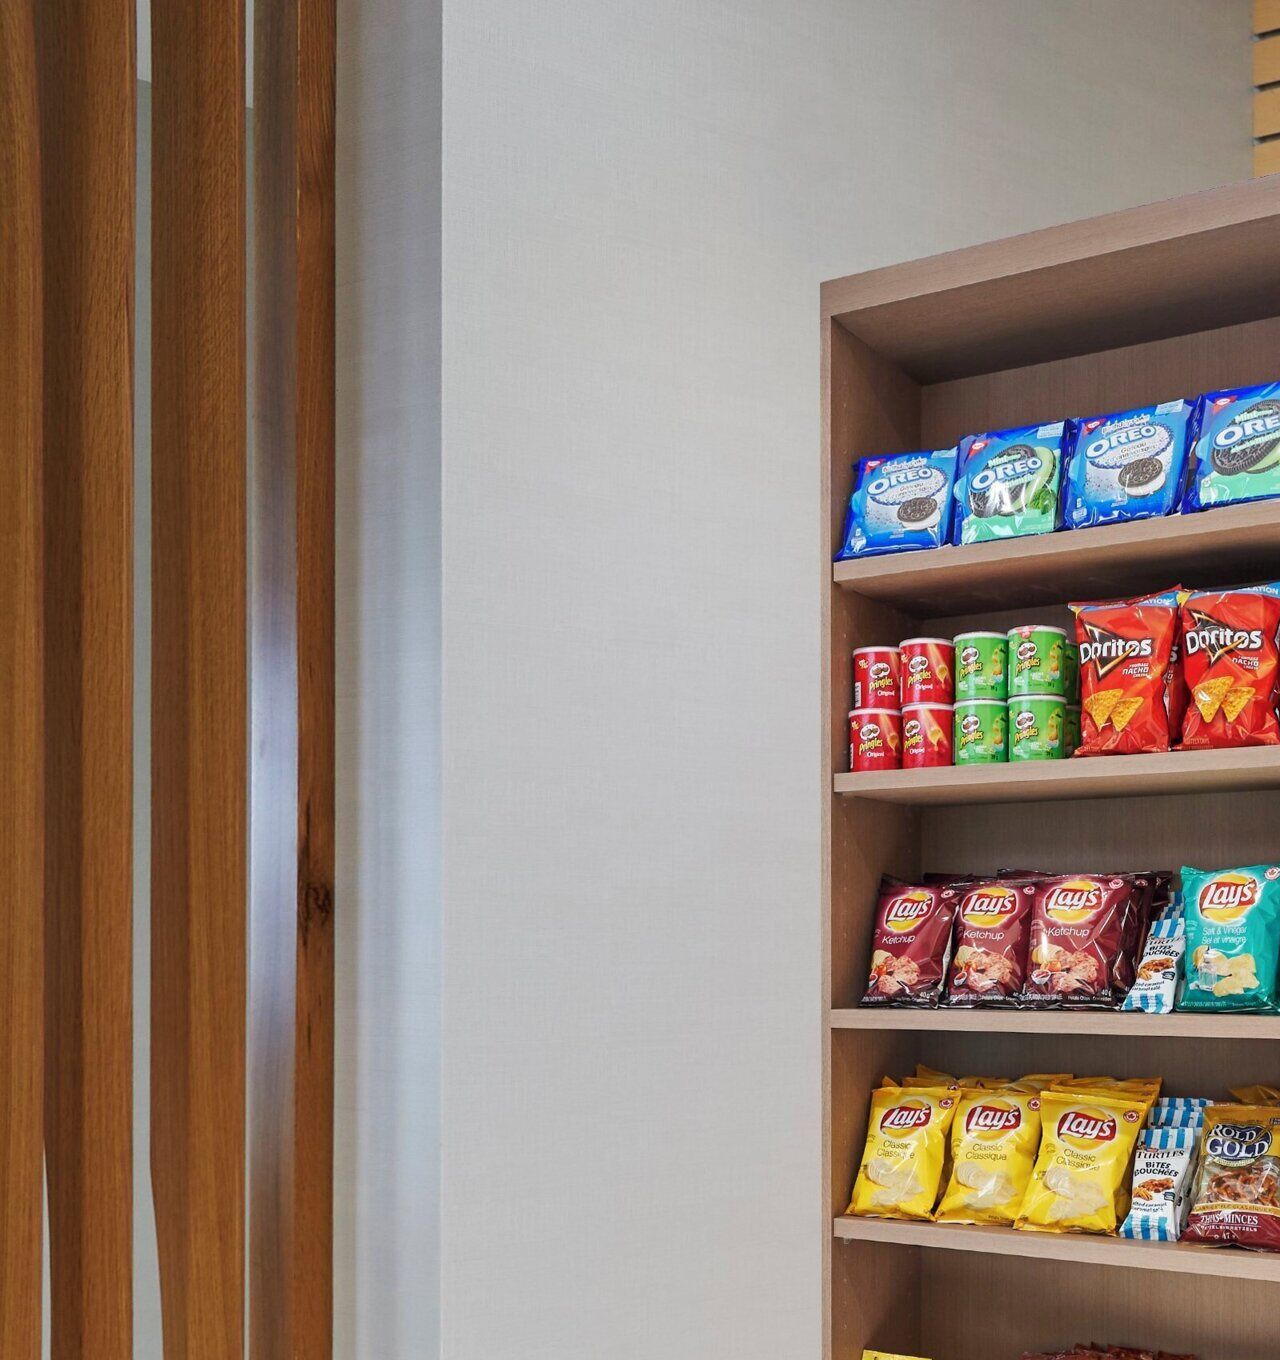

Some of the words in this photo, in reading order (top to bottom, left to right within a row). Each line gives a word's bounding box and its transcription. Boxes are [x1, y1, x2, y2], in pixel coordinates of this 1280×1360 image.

[1086, 426, 1155, 458] OREO
[867, 467, 932, 496] OREO
[972, 458, 1041, 491] OREO
[1080, 638, 1152, 664] Doritos
[1187, 627, 1262, 657] Doritos
[960, 661, 983, 677] Pringles
[1016, 658, 1040, 673] Pringles
[869, 677, 893, 693] Pringles
[908, 671, 931, 687] Pringles
[859, 739, 883, 756] Pringles
[904, 734, 923, 750] Pringles
[1046, 888, 1098, 911] Lay's
[1200, 878, 1258, 909] Lay's
[888, 897, 932, 922] Lay's
[963, 893, 1012, 915] Lay's
[882, 935, 915, 944] Ketchup
[963, 930, 1004, 941] Ketchup
[1048, 927, 1089, 938] Ketchup
[884, 1107, 931, 1128] Lay's
[1209, 1123, 1257, 1142] ROLD
[883, 1140, 911, 1150] Classic
[972, 1143, 1003, 1152] Classic
[1205, 1139, 1269, 1158] GOLD
[1064, 1148, 1096, 1162] Classic
